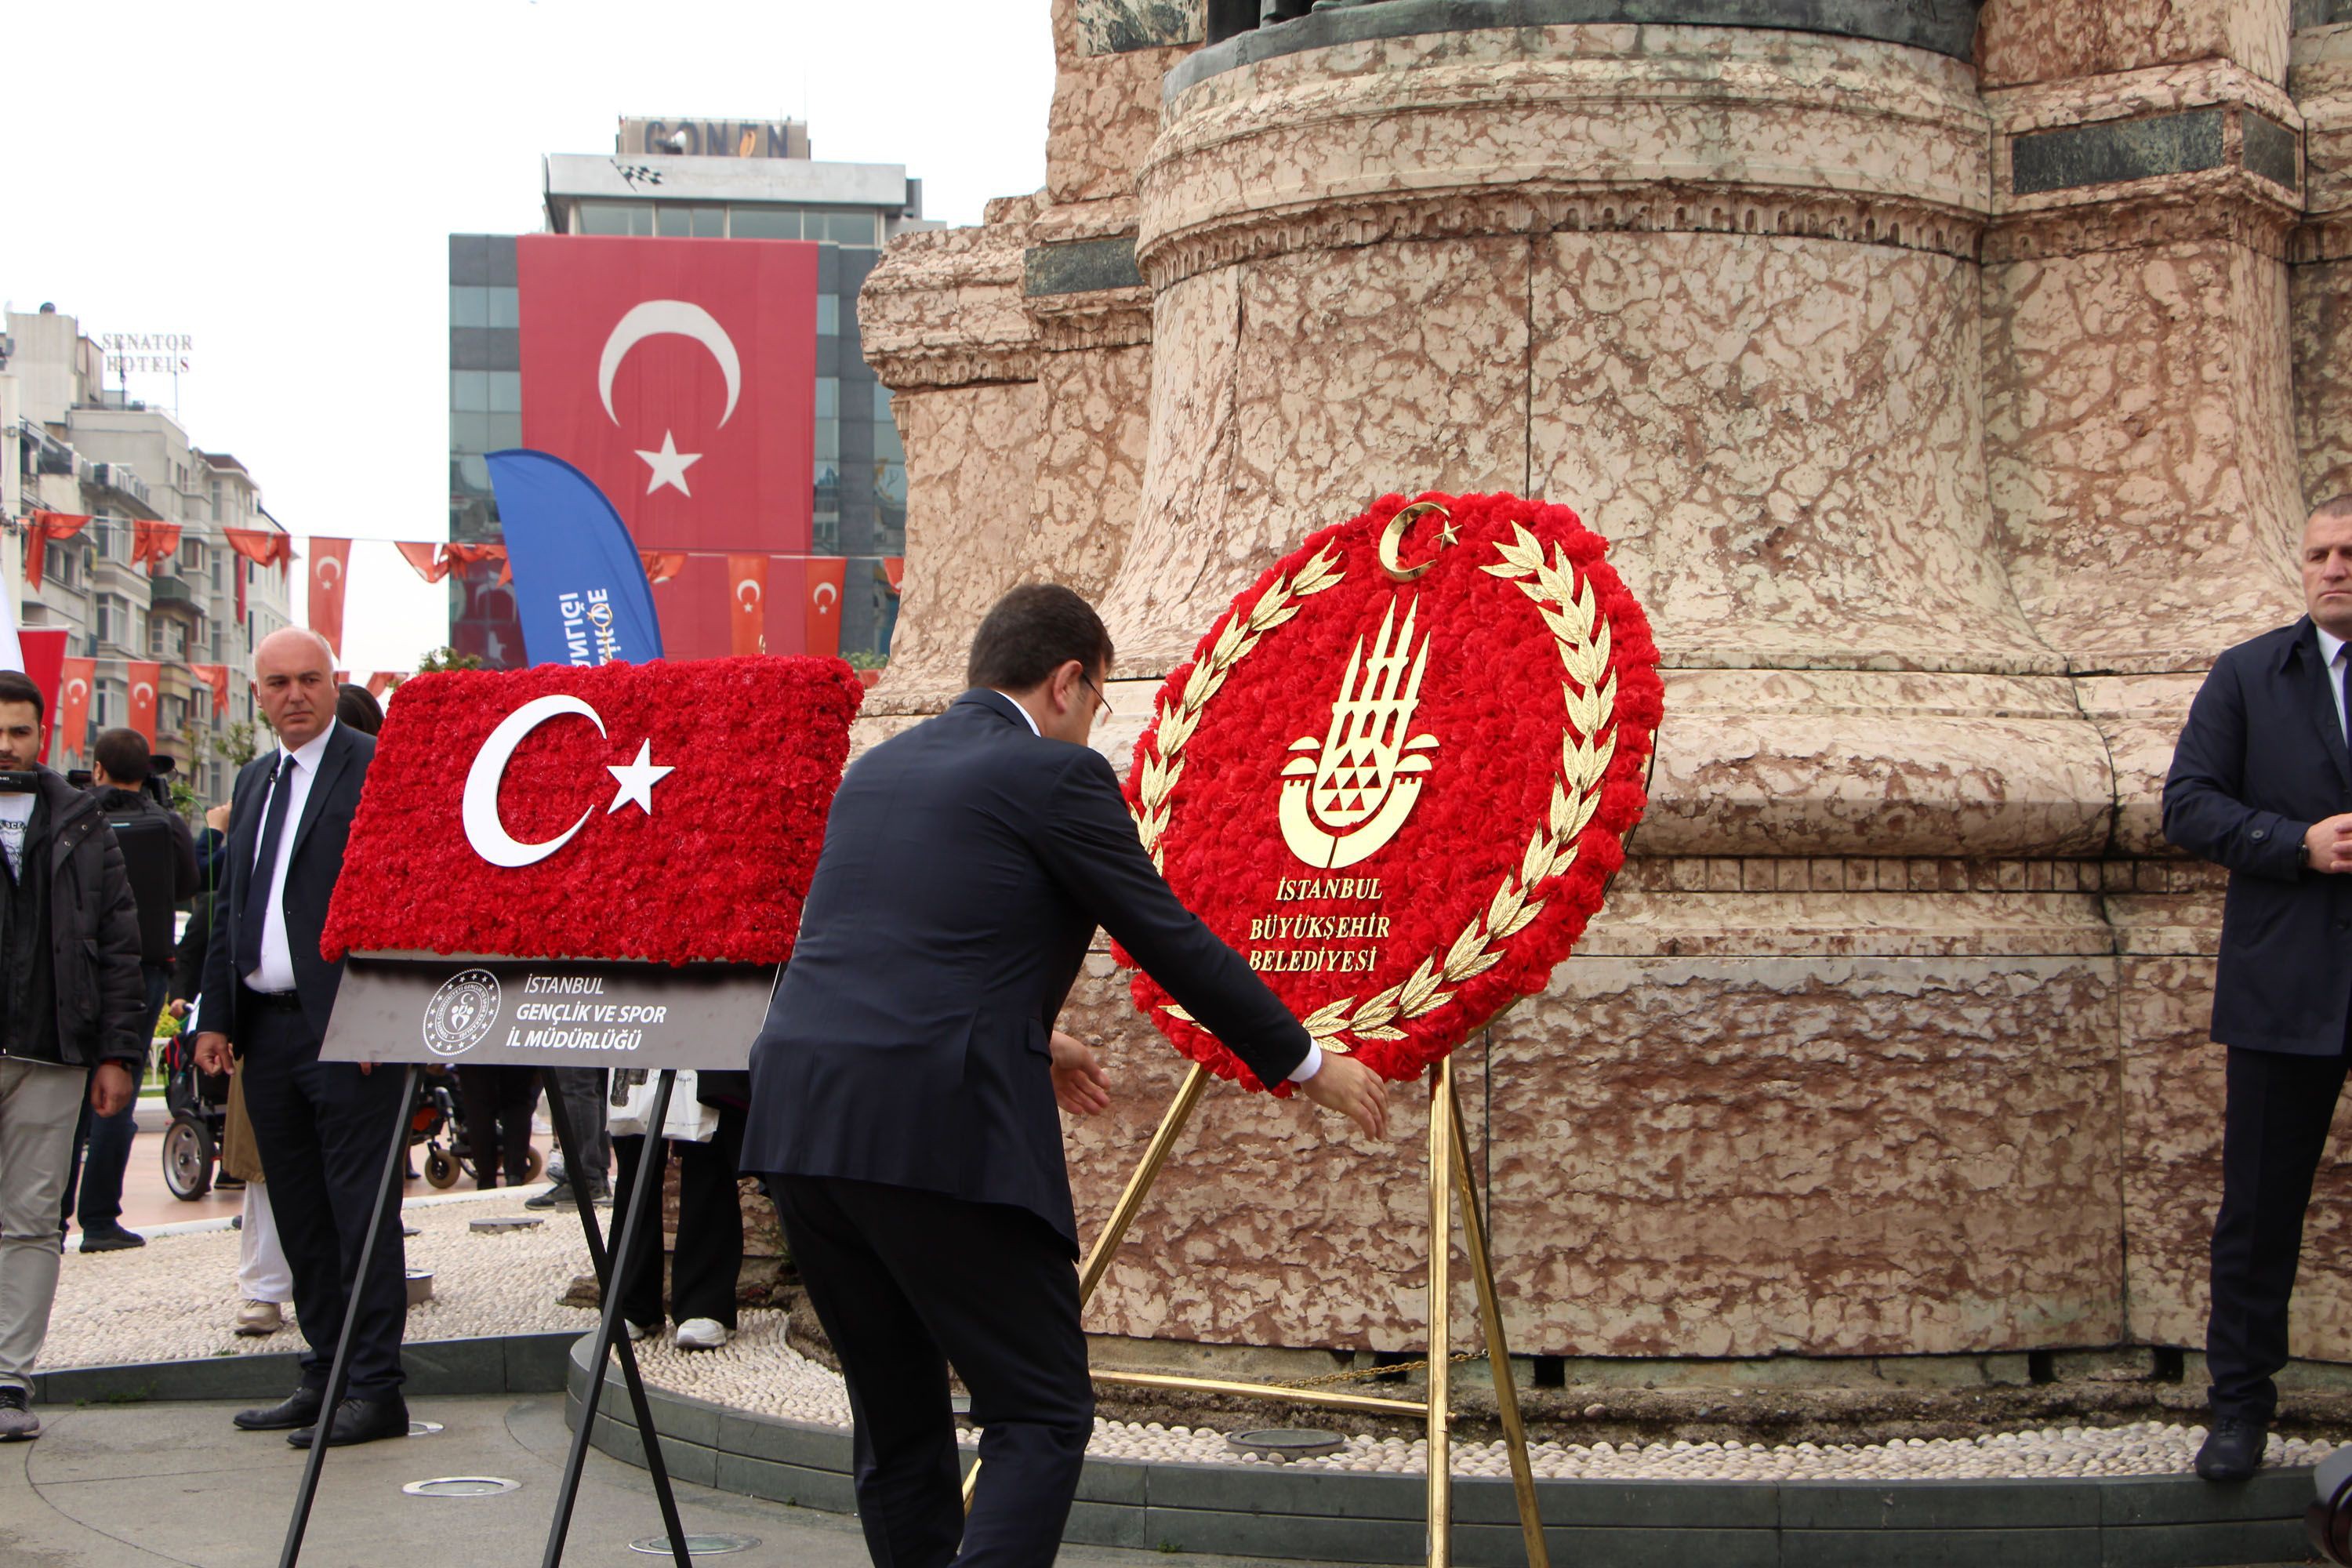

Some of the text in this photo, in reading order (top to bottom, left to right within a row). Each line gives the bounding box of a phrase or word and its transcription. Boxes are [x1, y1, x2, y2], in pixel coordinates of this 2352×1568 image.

[102, 333, 193, 350] SENATOR
[107, 356, 189, 373] HOTELS
[1276, 877, 1382, 901] İSTANBUL
[1249, 913, 1390, 940] BÜYÜKŞEHİR
[1249, 946, 1377, 972] BELEDİYESİ
[524, 973, 604, 994] İSTANBUL
[516, 1000, 666, 1025] GENÇLİK VE SPOR
[506, 1026, 642, 1051] İL MÜDÜRLÜĞÜ
